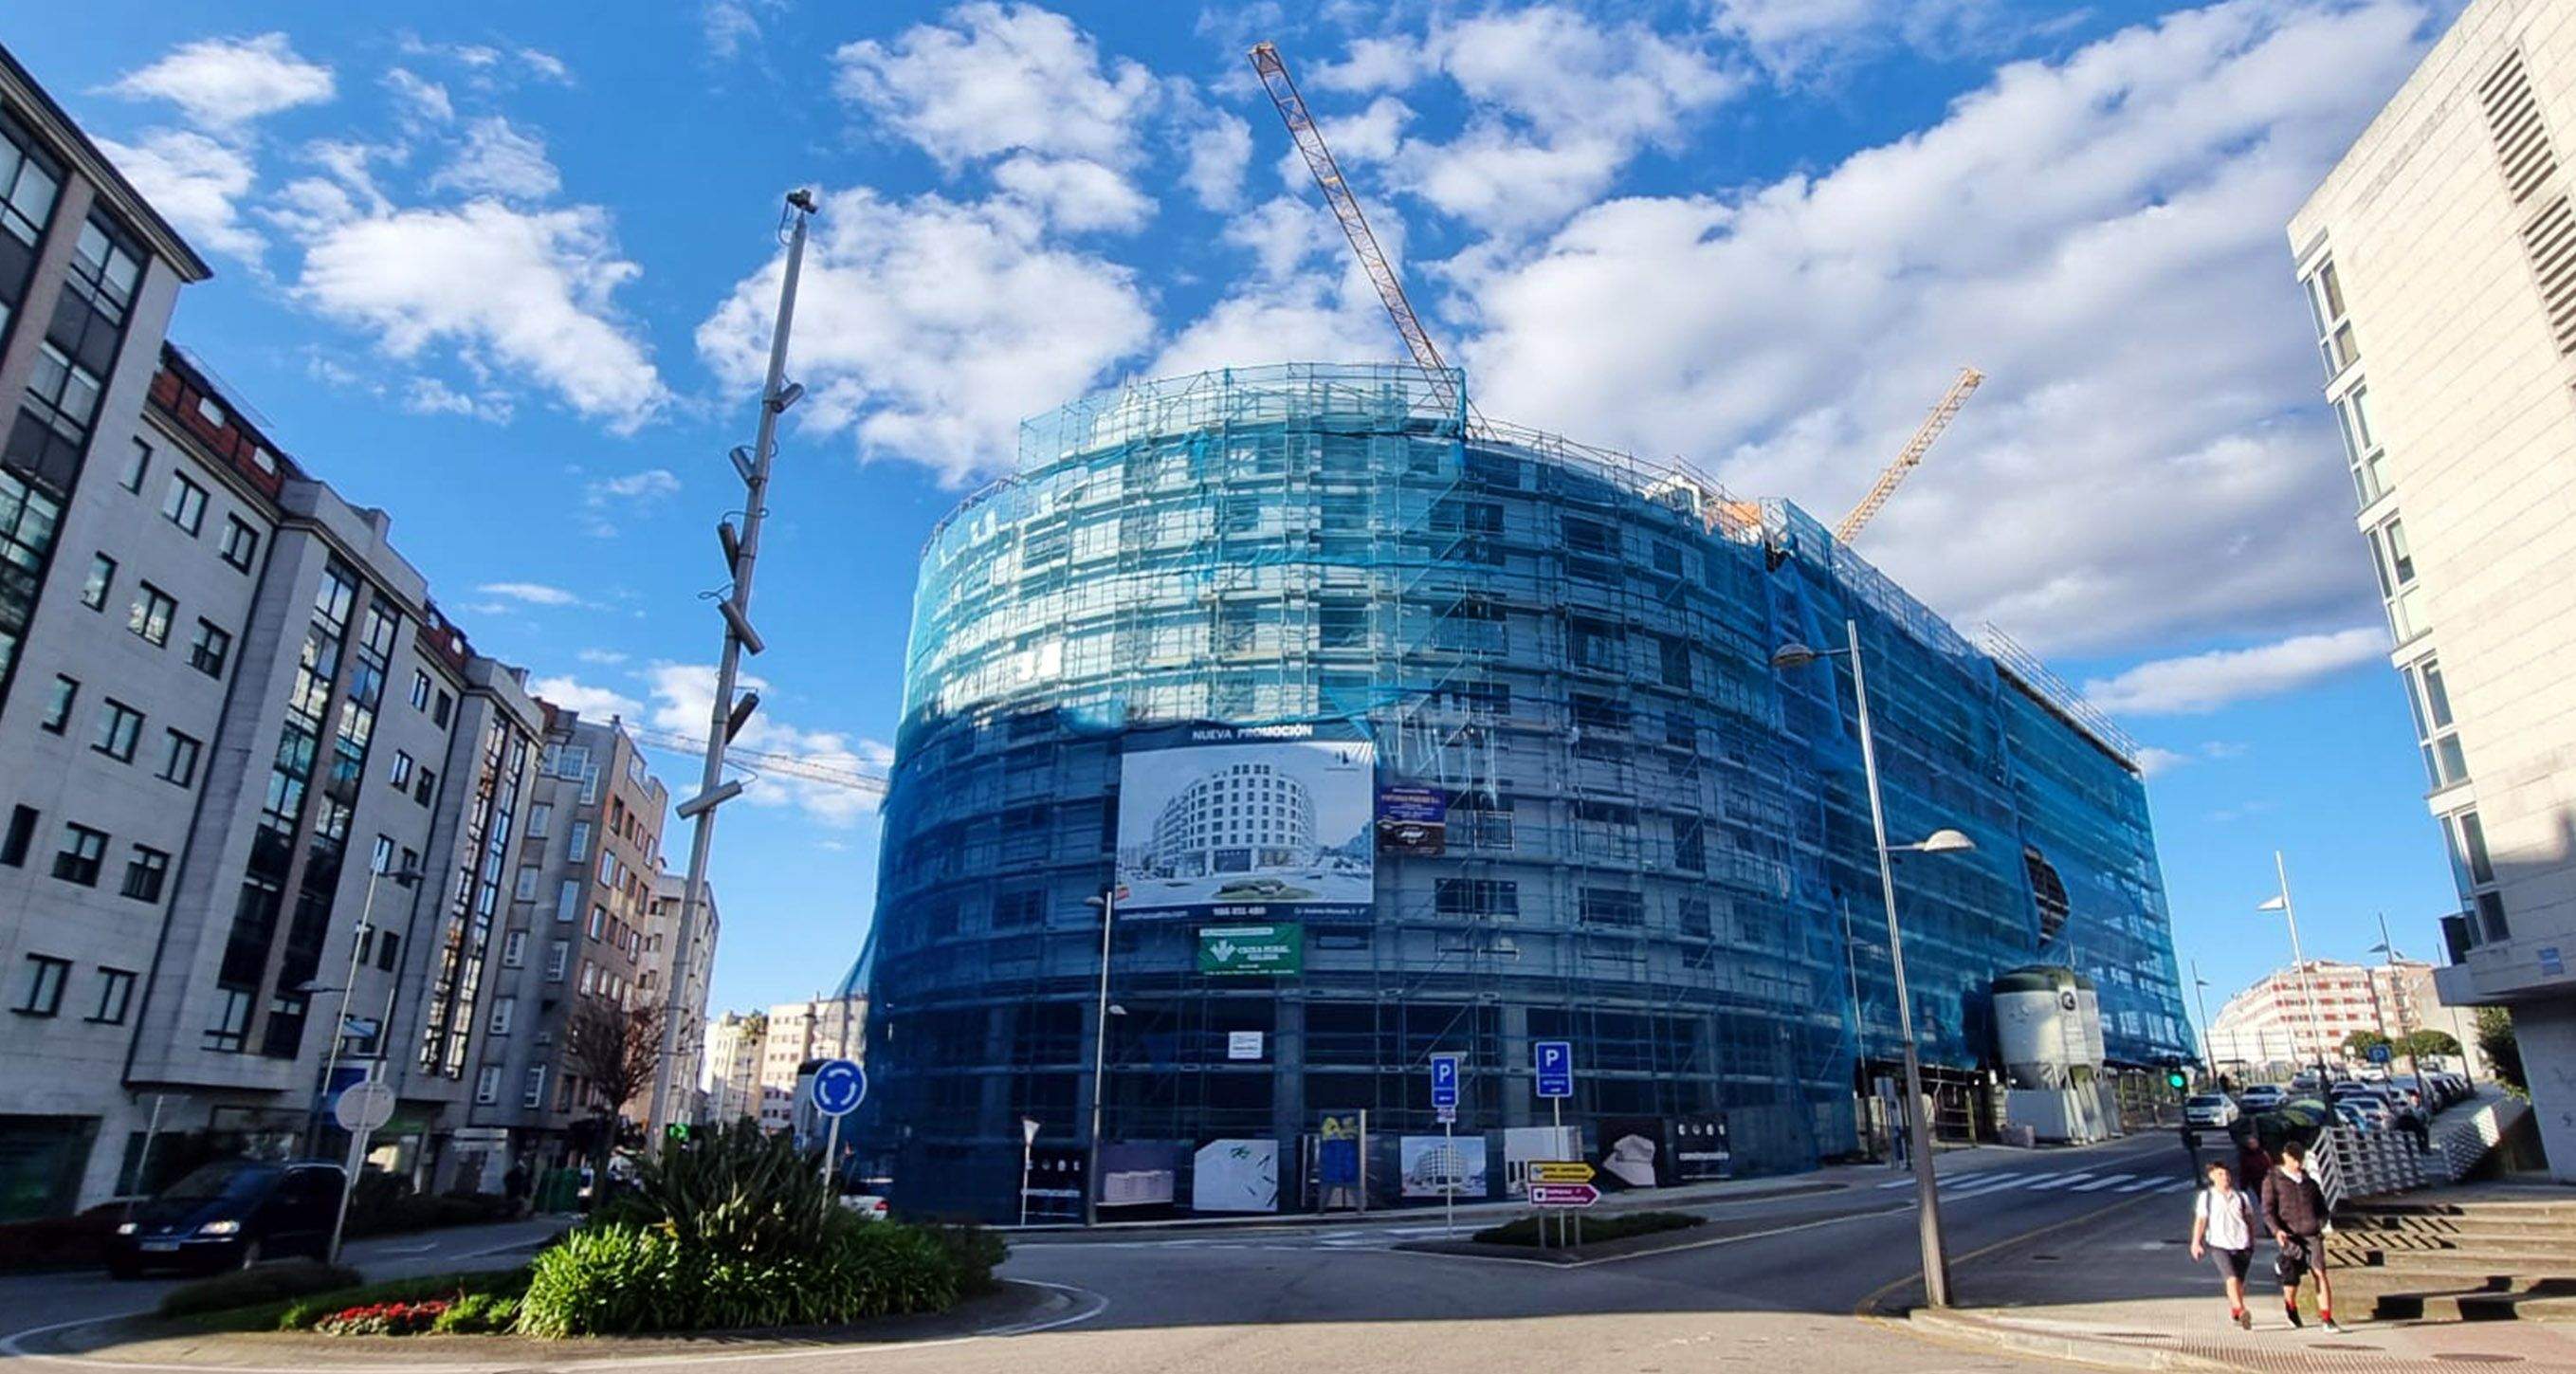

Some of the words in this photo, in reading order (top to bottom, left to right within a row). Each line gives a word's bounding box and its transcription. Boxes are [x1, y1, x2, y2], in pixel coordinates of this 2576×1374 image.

[1193, 729, 1233, 740] NUEVA
[1237, 724, 1313, 738] PROMOCIÓN
[1545, 1049, 1560, 1068] P
[1439, 1064, 1451, 1083] P
